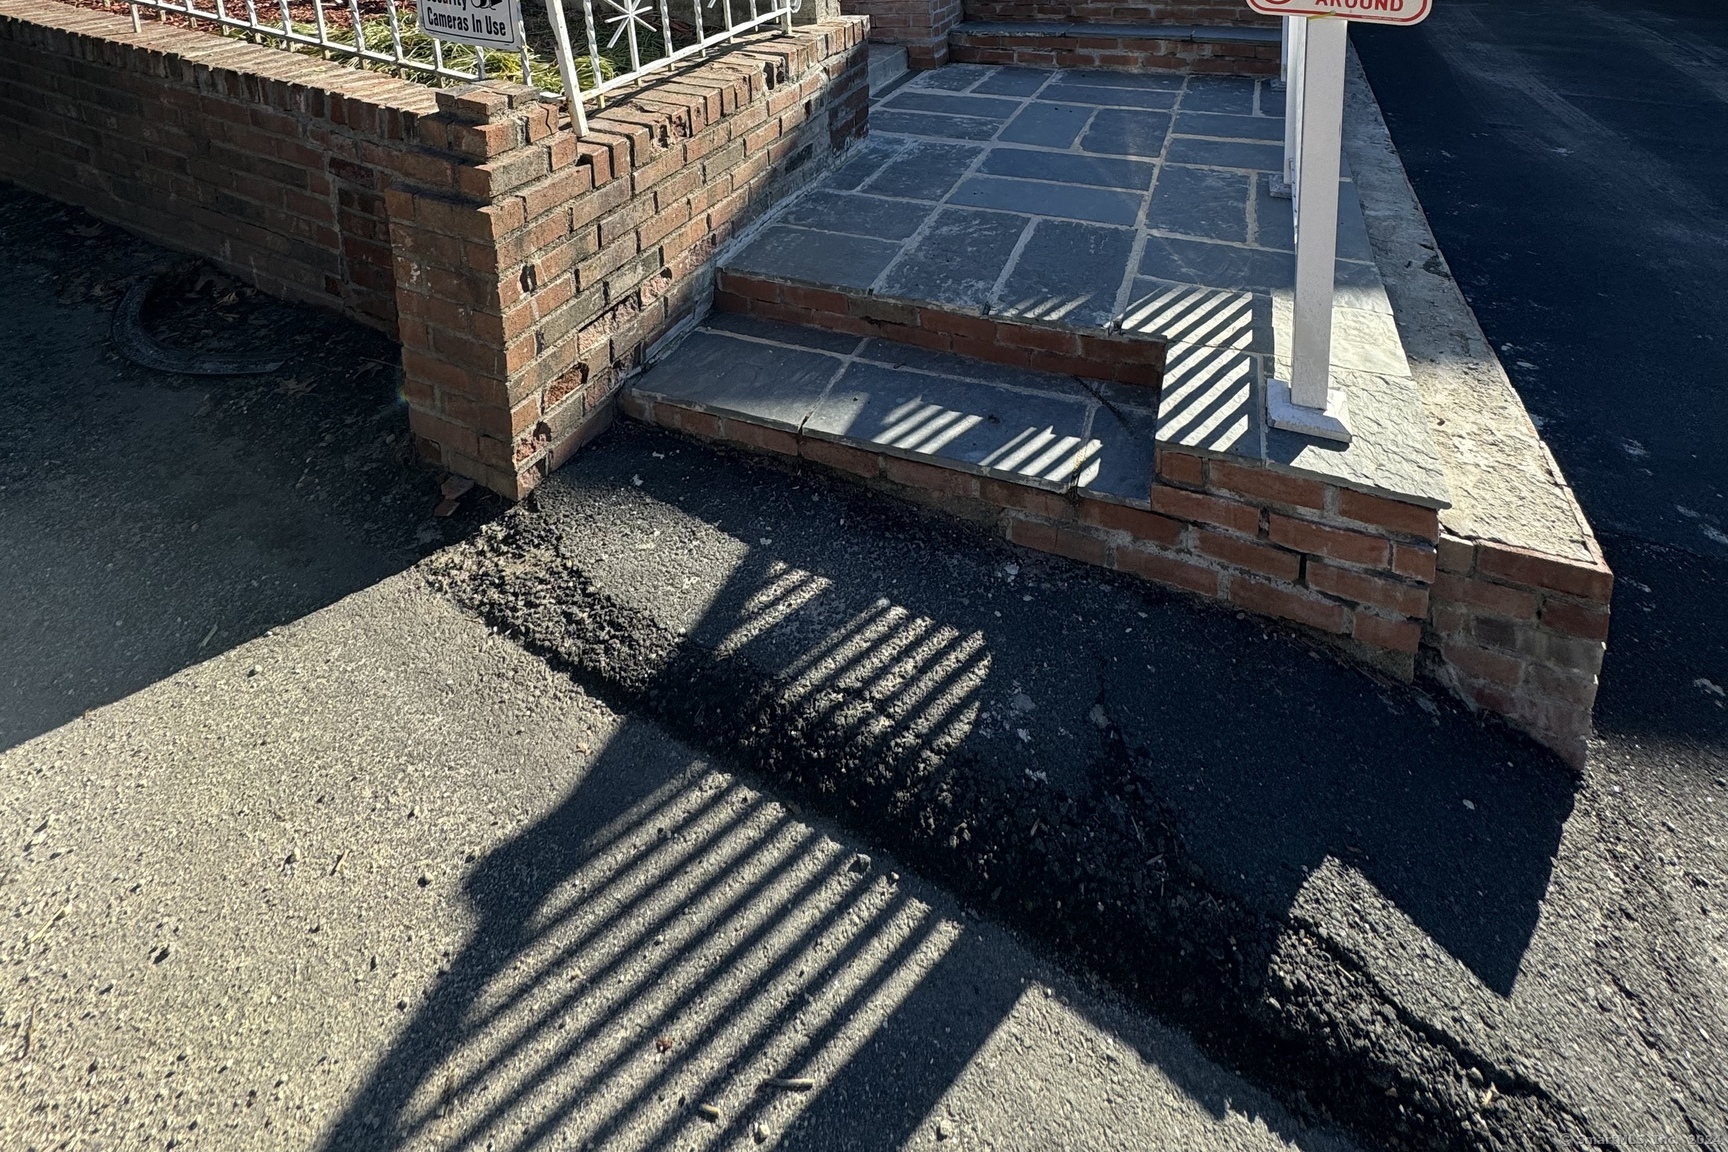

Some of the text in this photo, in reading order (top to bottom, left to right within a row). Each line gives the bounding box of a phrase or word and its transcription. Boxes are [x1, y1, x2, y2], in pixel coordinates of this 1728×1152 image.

[427, 7, 506, 36] Cameras In Use
